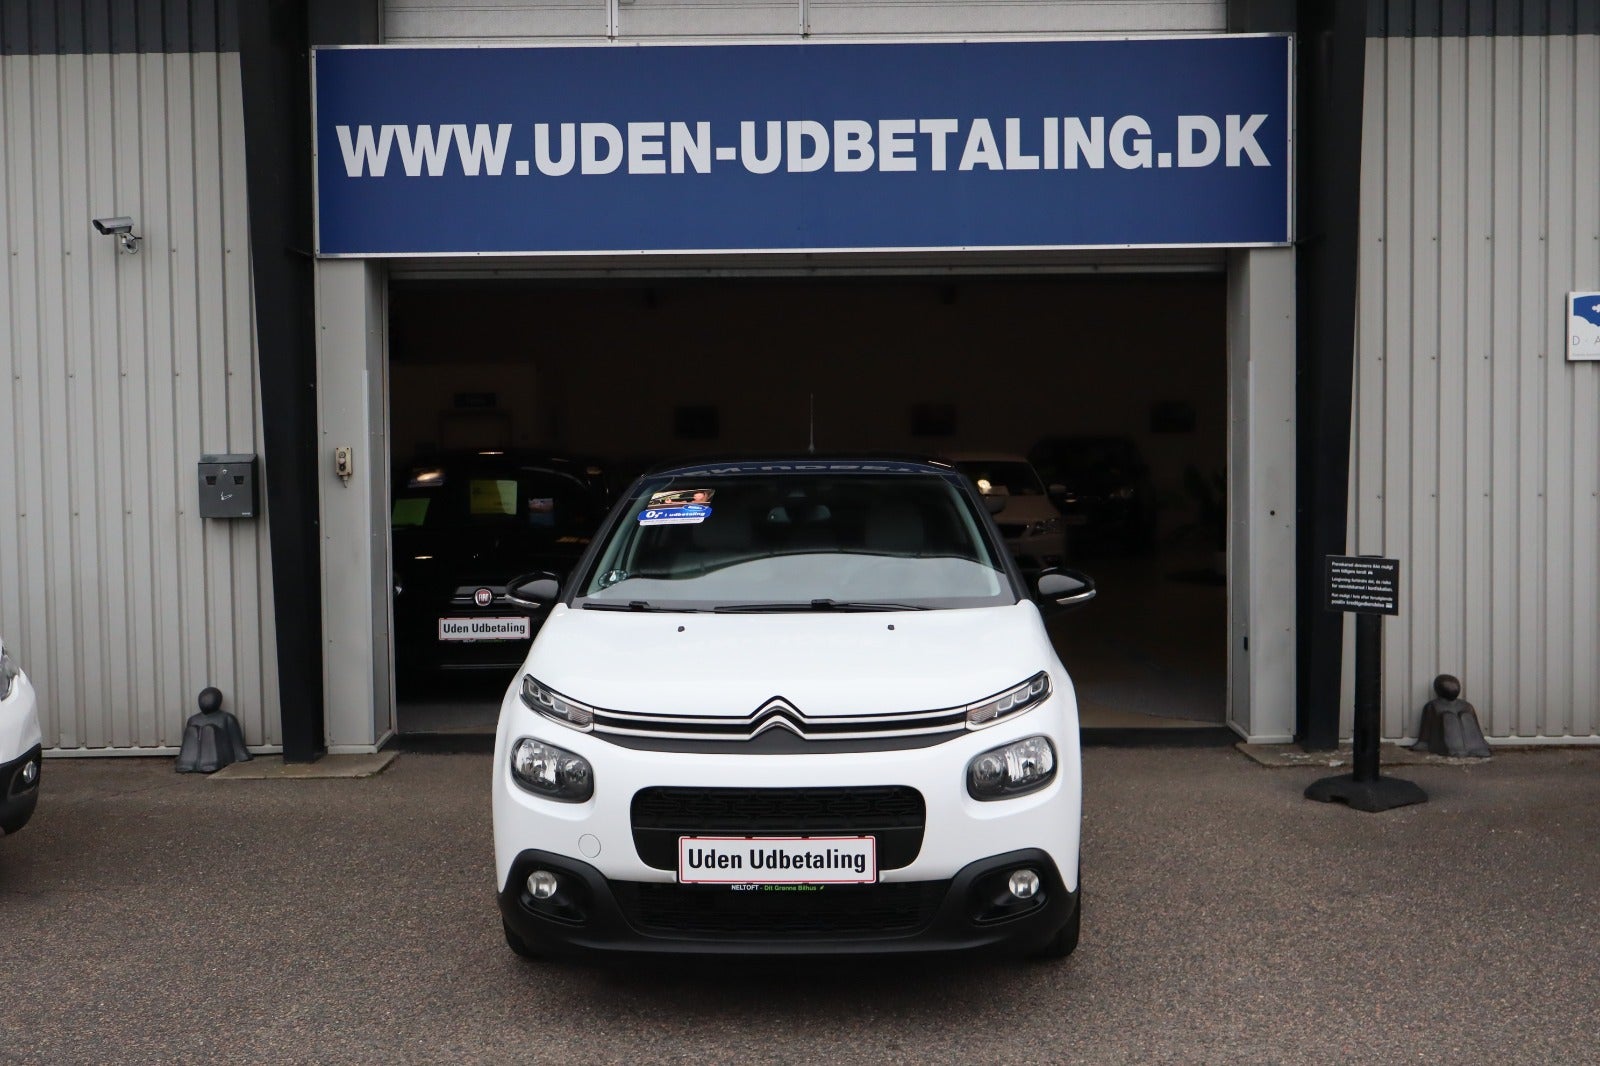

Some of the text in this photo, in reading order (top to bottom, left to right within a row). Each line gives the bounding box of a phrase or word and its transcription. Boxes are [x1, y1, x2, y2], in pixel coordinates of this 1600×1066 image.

[335, 113, 1270, 179] WWW.UDEN-UDBETALING.DK
[443, 622, 525, 634] Uden Udbetaling
[688, 848, 866, 874] Uden Udbetaling
